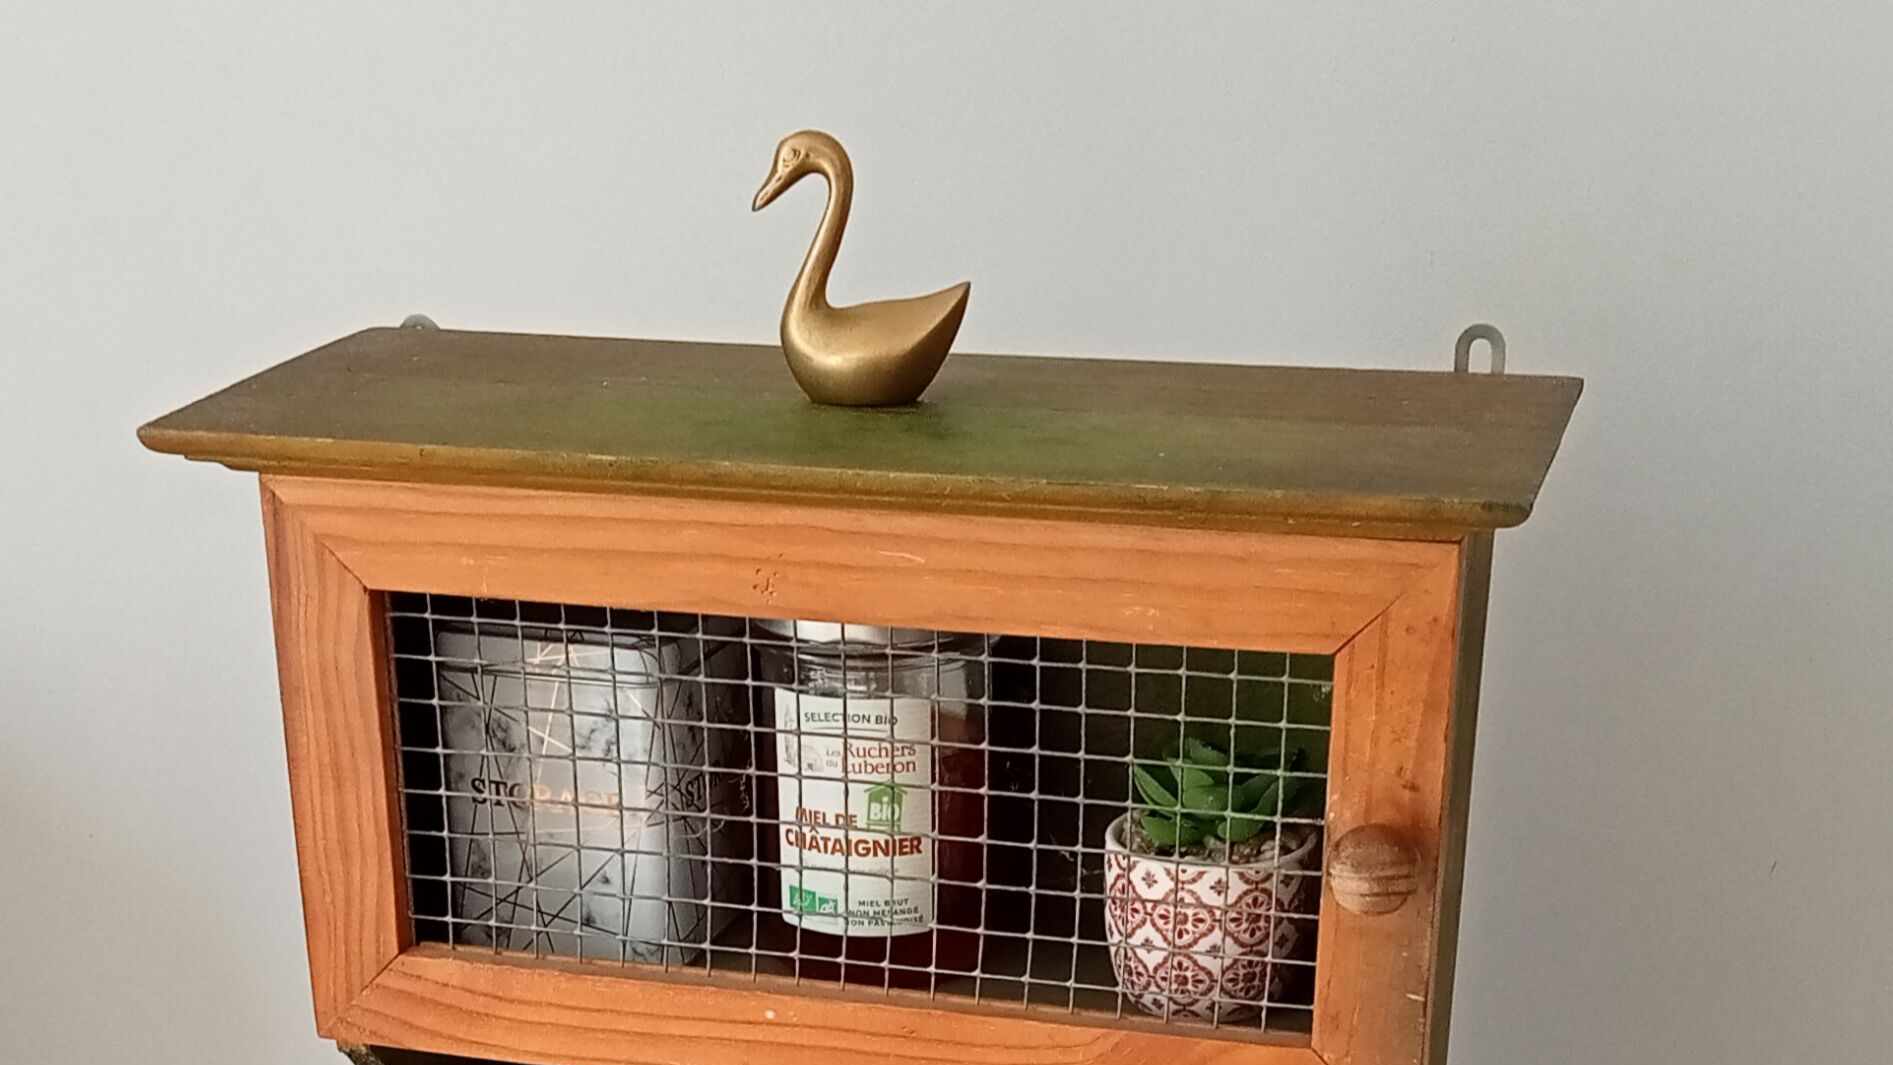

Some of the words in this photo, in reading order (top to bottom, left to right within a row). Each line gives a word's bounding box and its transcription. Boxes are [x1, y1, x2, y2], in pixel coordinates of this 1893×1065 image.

[795, 806, 830, 827] MIEL
[834, 813, 858, 829] DE
[785, 825, 923, 858] CHÂTAIGNIER
[858, 899, 882, 908] MIEL
